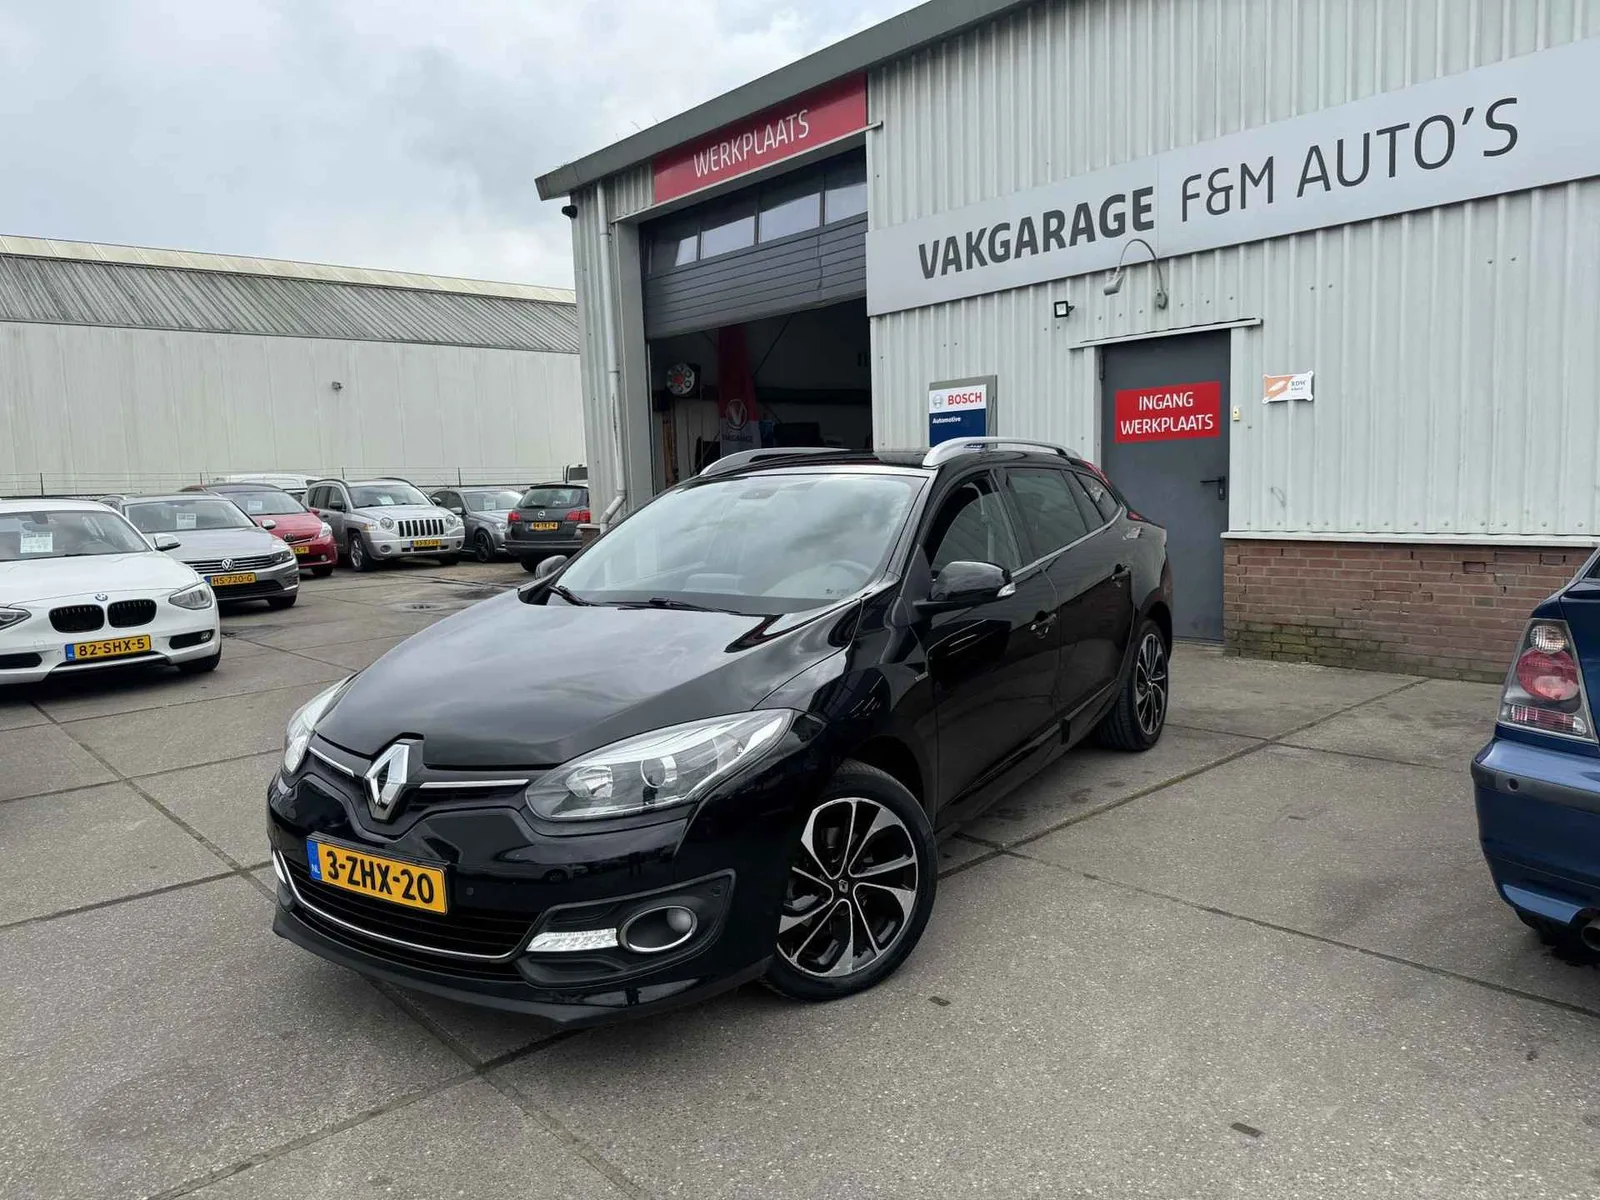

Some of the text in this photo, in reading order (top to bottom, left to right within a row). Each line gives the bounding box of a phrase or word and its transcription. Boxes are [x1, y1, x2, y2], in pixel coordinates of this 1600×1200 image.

[693, 109, 810, 178] WERKPLAATS
[918, 97, 1518, 280] VAKGARAGE F&M AUTO'S
[947, 391, 982, 406] BOSCH
[1139, 391, 1194, 411] INGANG
[932, 416, 962, 424] Automotive
[1120, 413, 1214, 435] WERKPLAATS
[79, 638, 146, 657] 82-SHX-5
[311, 863, 320, 874] NL
[326, 850, 434, 904] 3-ZHX-20
